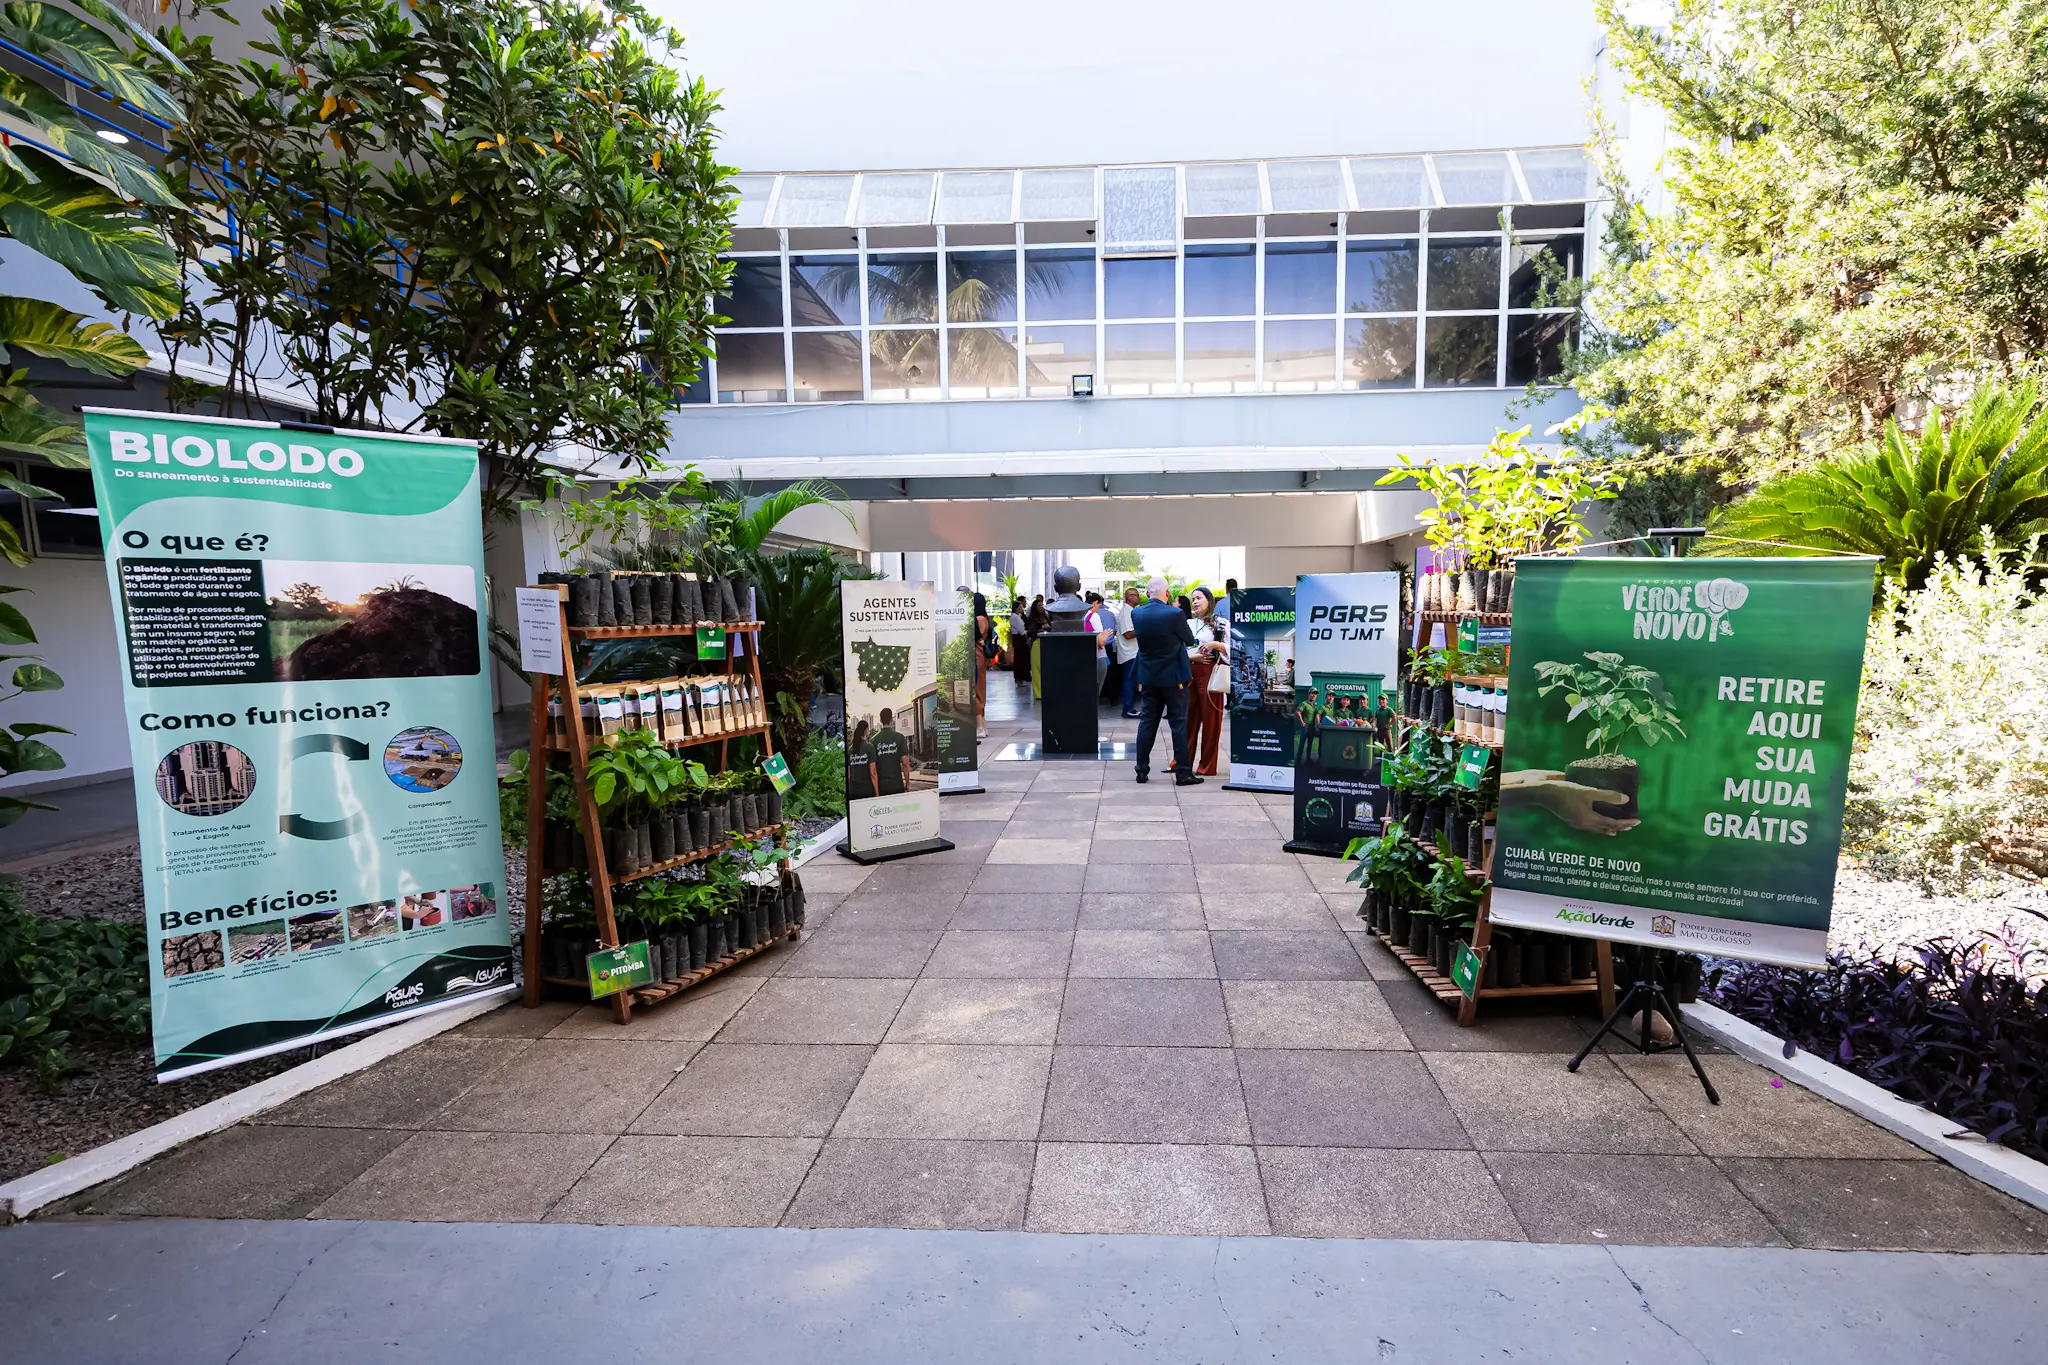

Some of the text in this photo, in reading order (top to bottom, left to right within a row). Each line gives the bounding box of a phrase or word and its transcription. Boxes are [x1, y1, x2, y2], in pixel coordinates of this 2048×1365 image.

[109, 431, 364, 477] BIOLODO
[114, 469, 332, 490] Do saneamento à sustentabilidade
[123, 530, 269, 554] O que é?
[196, 590, 219, 598] água
[864, 598, 916, 608] AGENTES
[1622, 584, 1692, 612] VERDE
[850, 609, 929, 622] SUSTENTÁVEIS
[1235, 611, 1295, 622] PLSCOMARCAS
[1309, 605, 1388, 623] PGRS
[1309, 628, 1384, 640] DO TJMT
[1634, 612, 1706, 640] NOVO
[188, 638, 227, 646] orgânica
[150, 671, 188, 679] projetos
[178, 661, 255, 669] desenvolvimento
[1326, 683, 1366, 691] COOPERATIVA
[1718, 676, 1825, 705] RETIRE
[140, 701, 390, 731] Como funciona?
[1747, 711, 1822, 739] AQUI
[1755, 746, 1816, 774] SUA
[1724, 778, 1812, 808] MUDA
[172, 827, 217, 836] Tratamento
[203, 832, 229, 840] Esgoto
[1704, 810, 1808, 845] GRÁTIS
[1505, 847, 1641, 872] CUIABÁ VERDE DE NOVO
[1504, 869, 1526, 879] Pegue
[1528, 873, 1541, 881] sua
[1543, 875, 1565, 884] muda,
[1567, 878, 1591, 888] plante
[1600, 882, 1620, 891] deixe
[1622, 884, 1649, 895] Cuiabá
[1651, 887, 1673, 898] ainda
[1675, 892, 1694, 900] mais
[1697, 894, 1744, 906] arborizada!
[1505, 859, 1528, 869] Cuiabá
[1530, 863, 1544, 871] tem
[1560, 866, 1590, 877] colorido
[1592, 870, 1609, 879] todo
[1611, 873, 1643, 884] especial,
[1646, 878, 1663, 886] mas
[1673, 880, 1694, 890] verde
[1697, 884, 1727, 894] sempre
[1730, 887, 1741, 895] foi
[1743, 890, 1758, 898] sua
[1761, 892, 1774, 900] cor
[1777, 893, 1819, 905] preferida.
[160, 889, 337, 930] Benefícios:
[1555, 908, 1635, 929] AçãoVerde
[1680, 922, 1752, 938] PODER JUDICIÁRIO
[1680, 930, 1751, 946] MATO GROSSO
[475, 962, 507, 982] IGUÁ
[611, 961, 644, 976] PITOMBA
[385, 983, 424, 1004] ÁGUAS
[392, 995, 418, 1008] CUIABÁ
